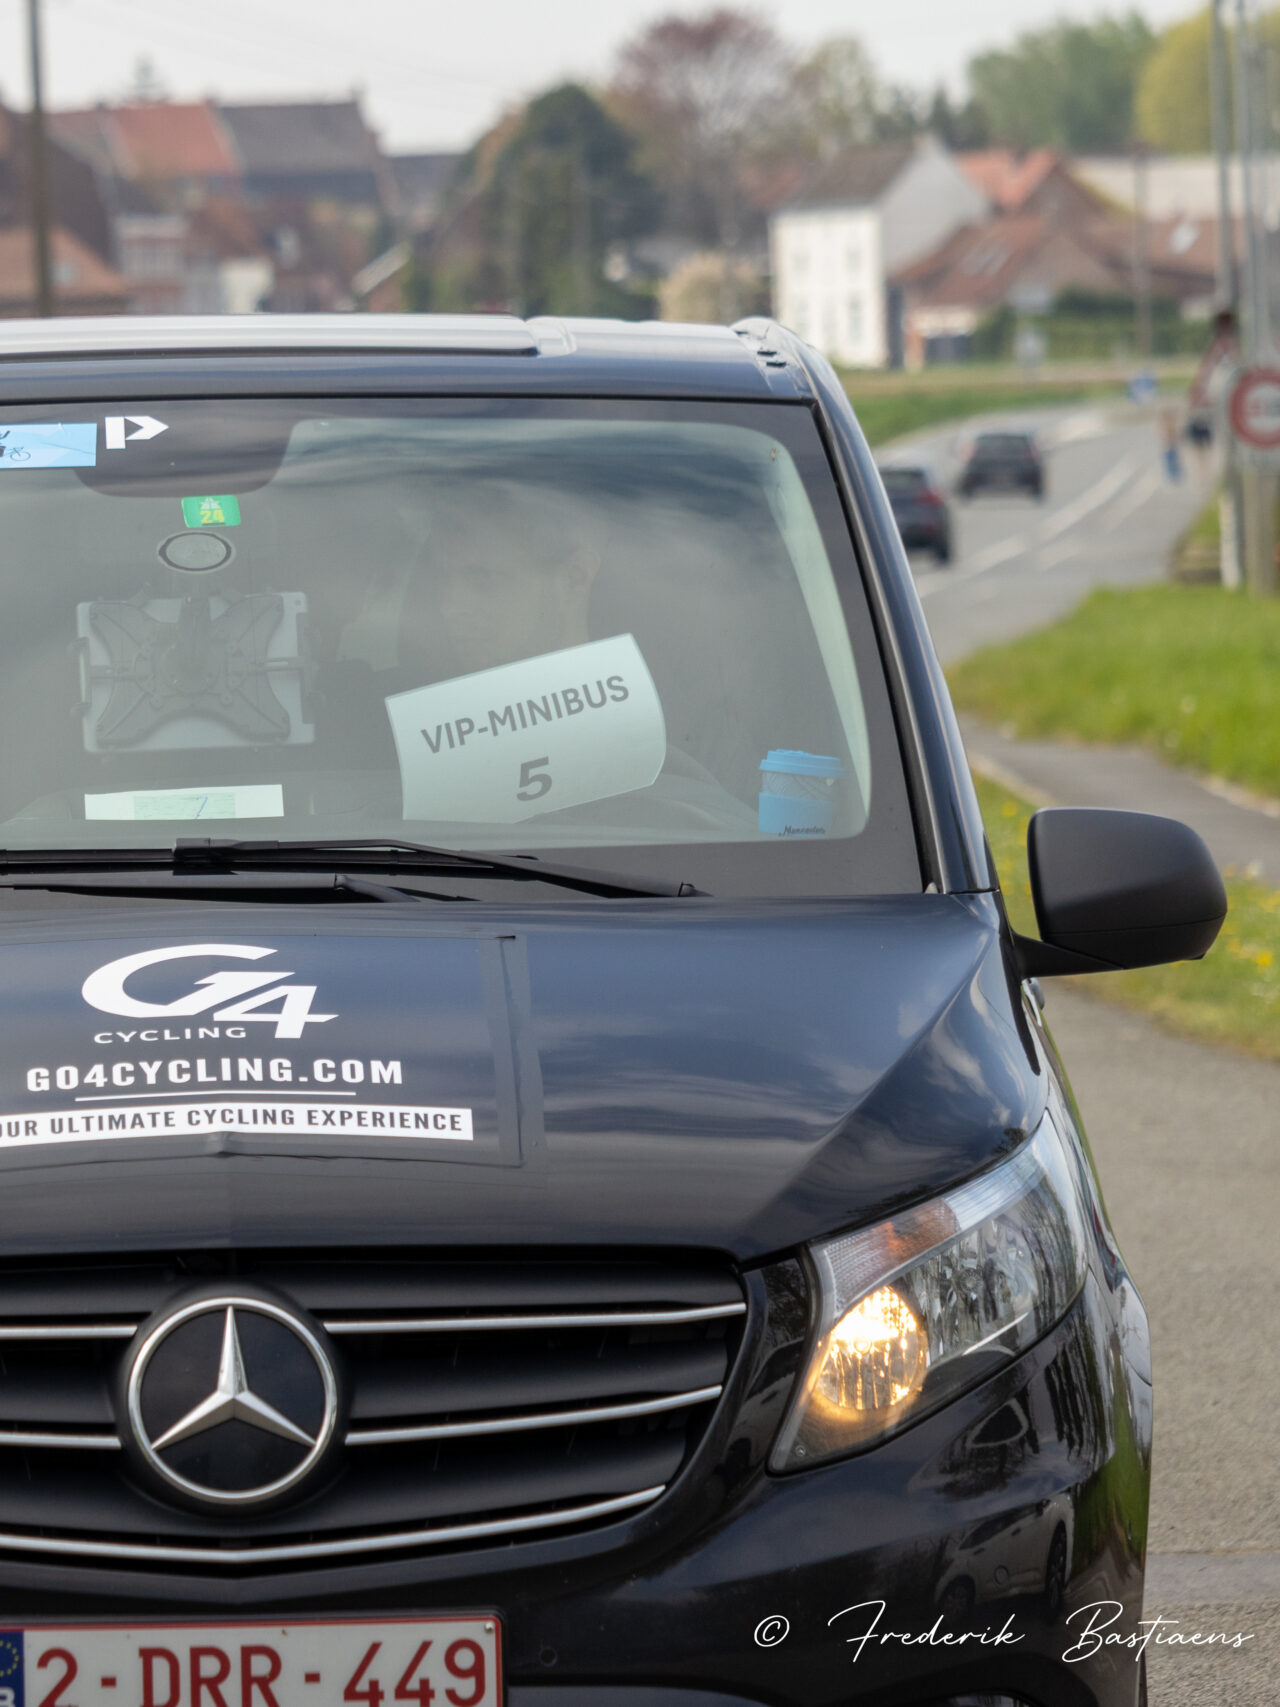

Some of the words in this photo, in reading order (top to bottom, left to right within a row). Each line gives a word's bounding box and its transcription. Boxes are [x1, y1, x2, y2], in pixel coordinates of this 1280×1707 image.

[421, 675, 629, 755] VIP-MINIBUS
[516, 758, 552, 802] 5
[82, 943, 339, 1039] G4
[94, 1027, 246, 1044] CYCLING
[26, 1057, 403, 1092] GO4CYCLING.COM
[50, 1111, 176, 1135] ULTIMATE
[187, 1108, 296, 1127] CYCLING
[307, 1109, 464, 1132] EXPERIENCE
